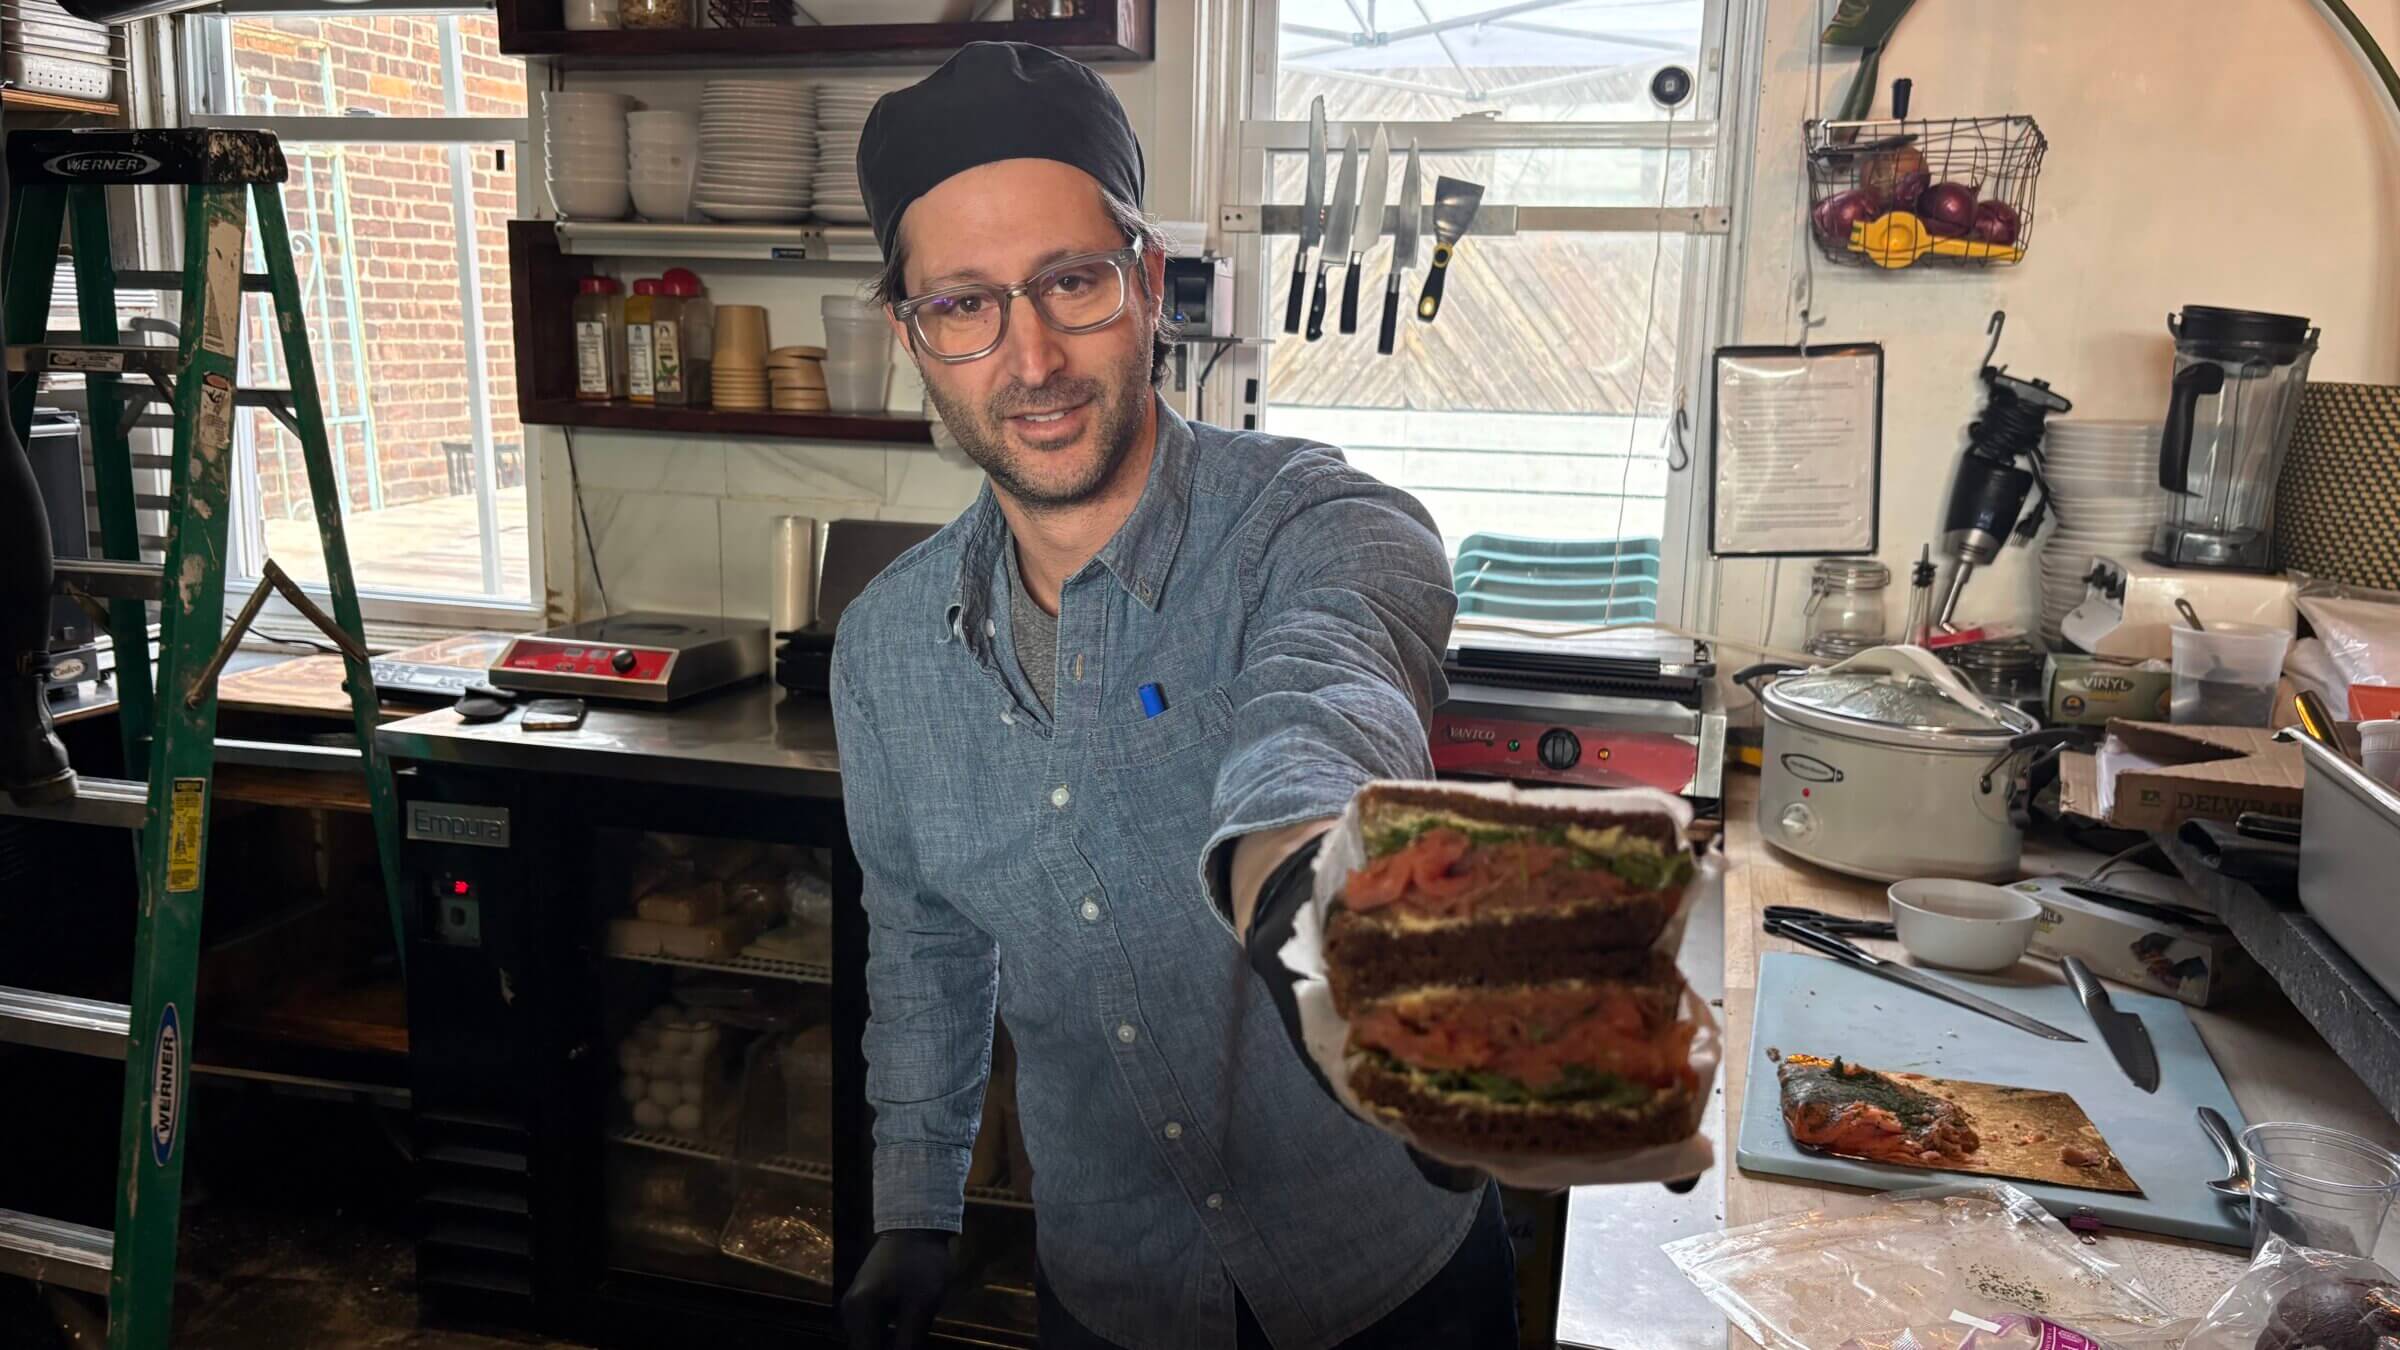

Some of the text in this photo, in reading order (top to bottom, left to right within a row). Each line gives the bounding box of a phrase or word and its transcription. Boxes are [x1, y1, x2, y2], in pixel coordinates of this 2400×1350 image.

[66, 159, 138, 171] WERNER
[2083, 676, 2128, 691] VINYL
[415, 808, 503, 840] Empura
[159, 1035, 174, 1133] WERNER
